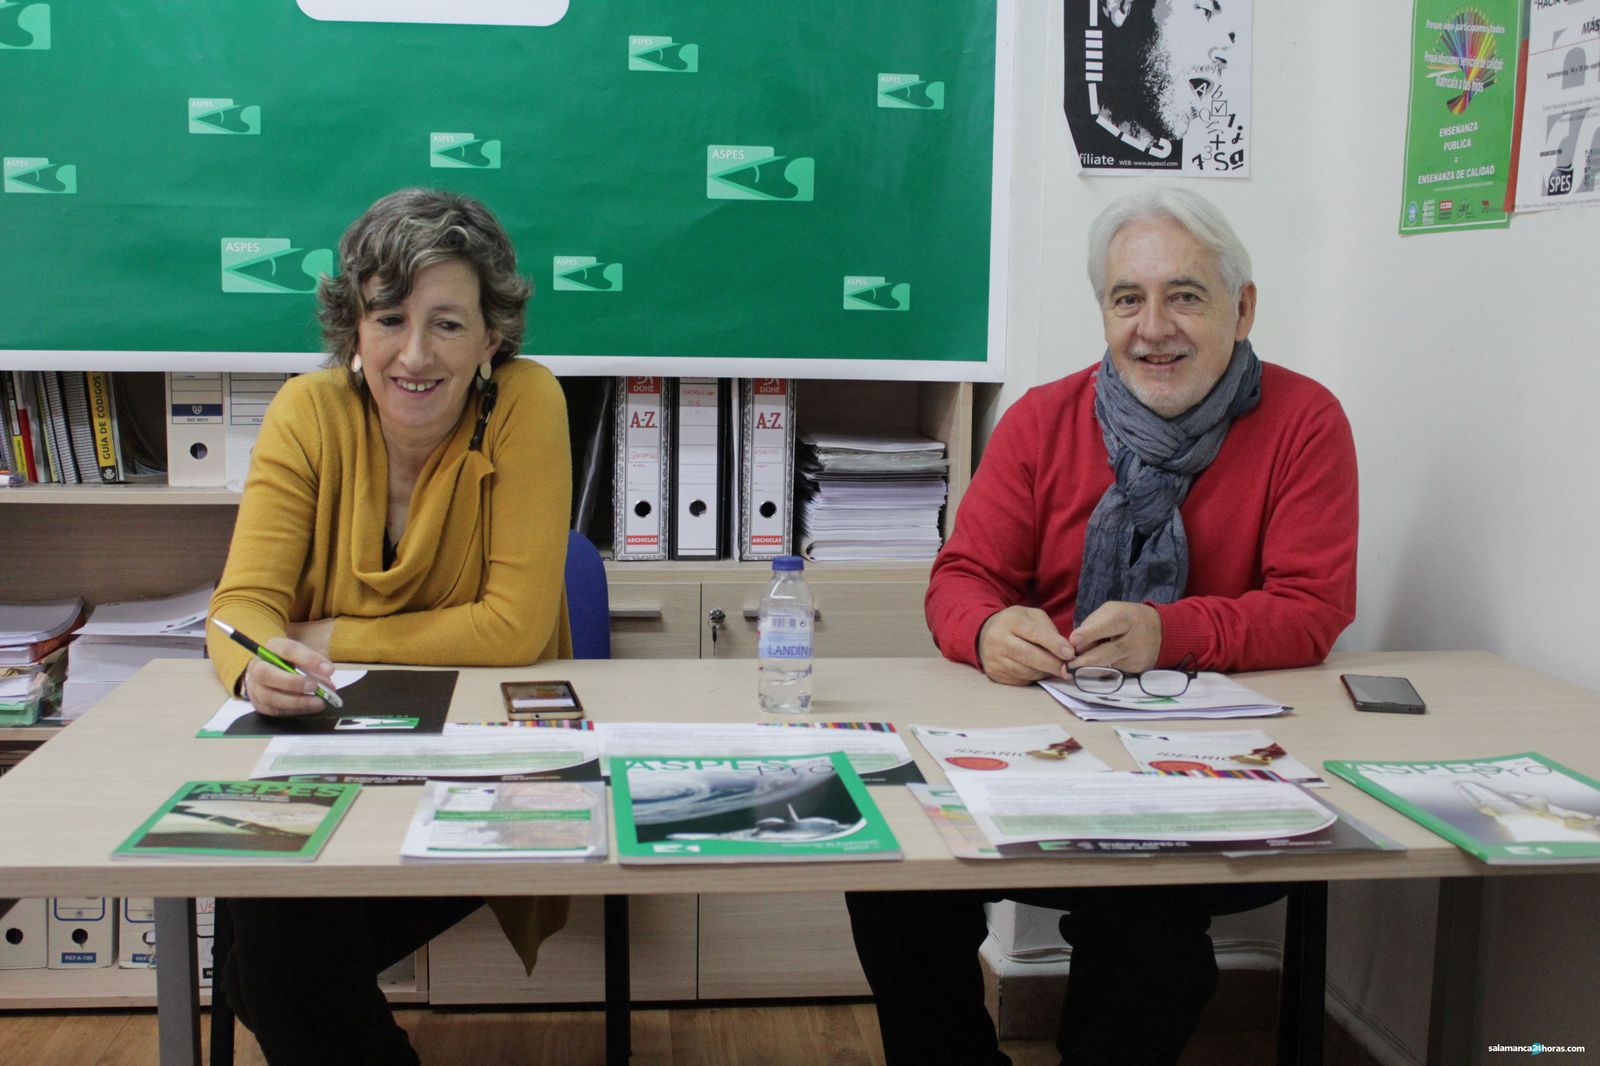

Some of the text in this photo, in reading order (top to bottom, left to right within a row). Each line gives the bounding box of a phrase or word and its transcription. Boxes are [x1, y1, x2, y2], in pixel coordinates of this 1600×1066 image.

[632, 37, 653, 45] ASPES
[881, 75, 901, 83] ASPES
[192, 100, 214, 108] ASPES
[433, 135, 454, 143] ASPES
[712, 149, 744, 159] ASPES
[7, 159, 28, 167] ASPES
[1466, 165, 1495, 178] CALIDAD
[1549, 174, 1571, 193] SPES
[226, 242, 260, 252] ASPES
[99, 421, 107, 434] DE
[100, 437, 111, 460] GUÍA
[627, 536, 658, 544] ARCHICLAS
[752, 536, 782, 544] ARCHICLAS
[625, 758, 794, 773] ASPES
[1347, 761, 1502, 776] ASPES
[190, 783, 346, 797] ASPES
